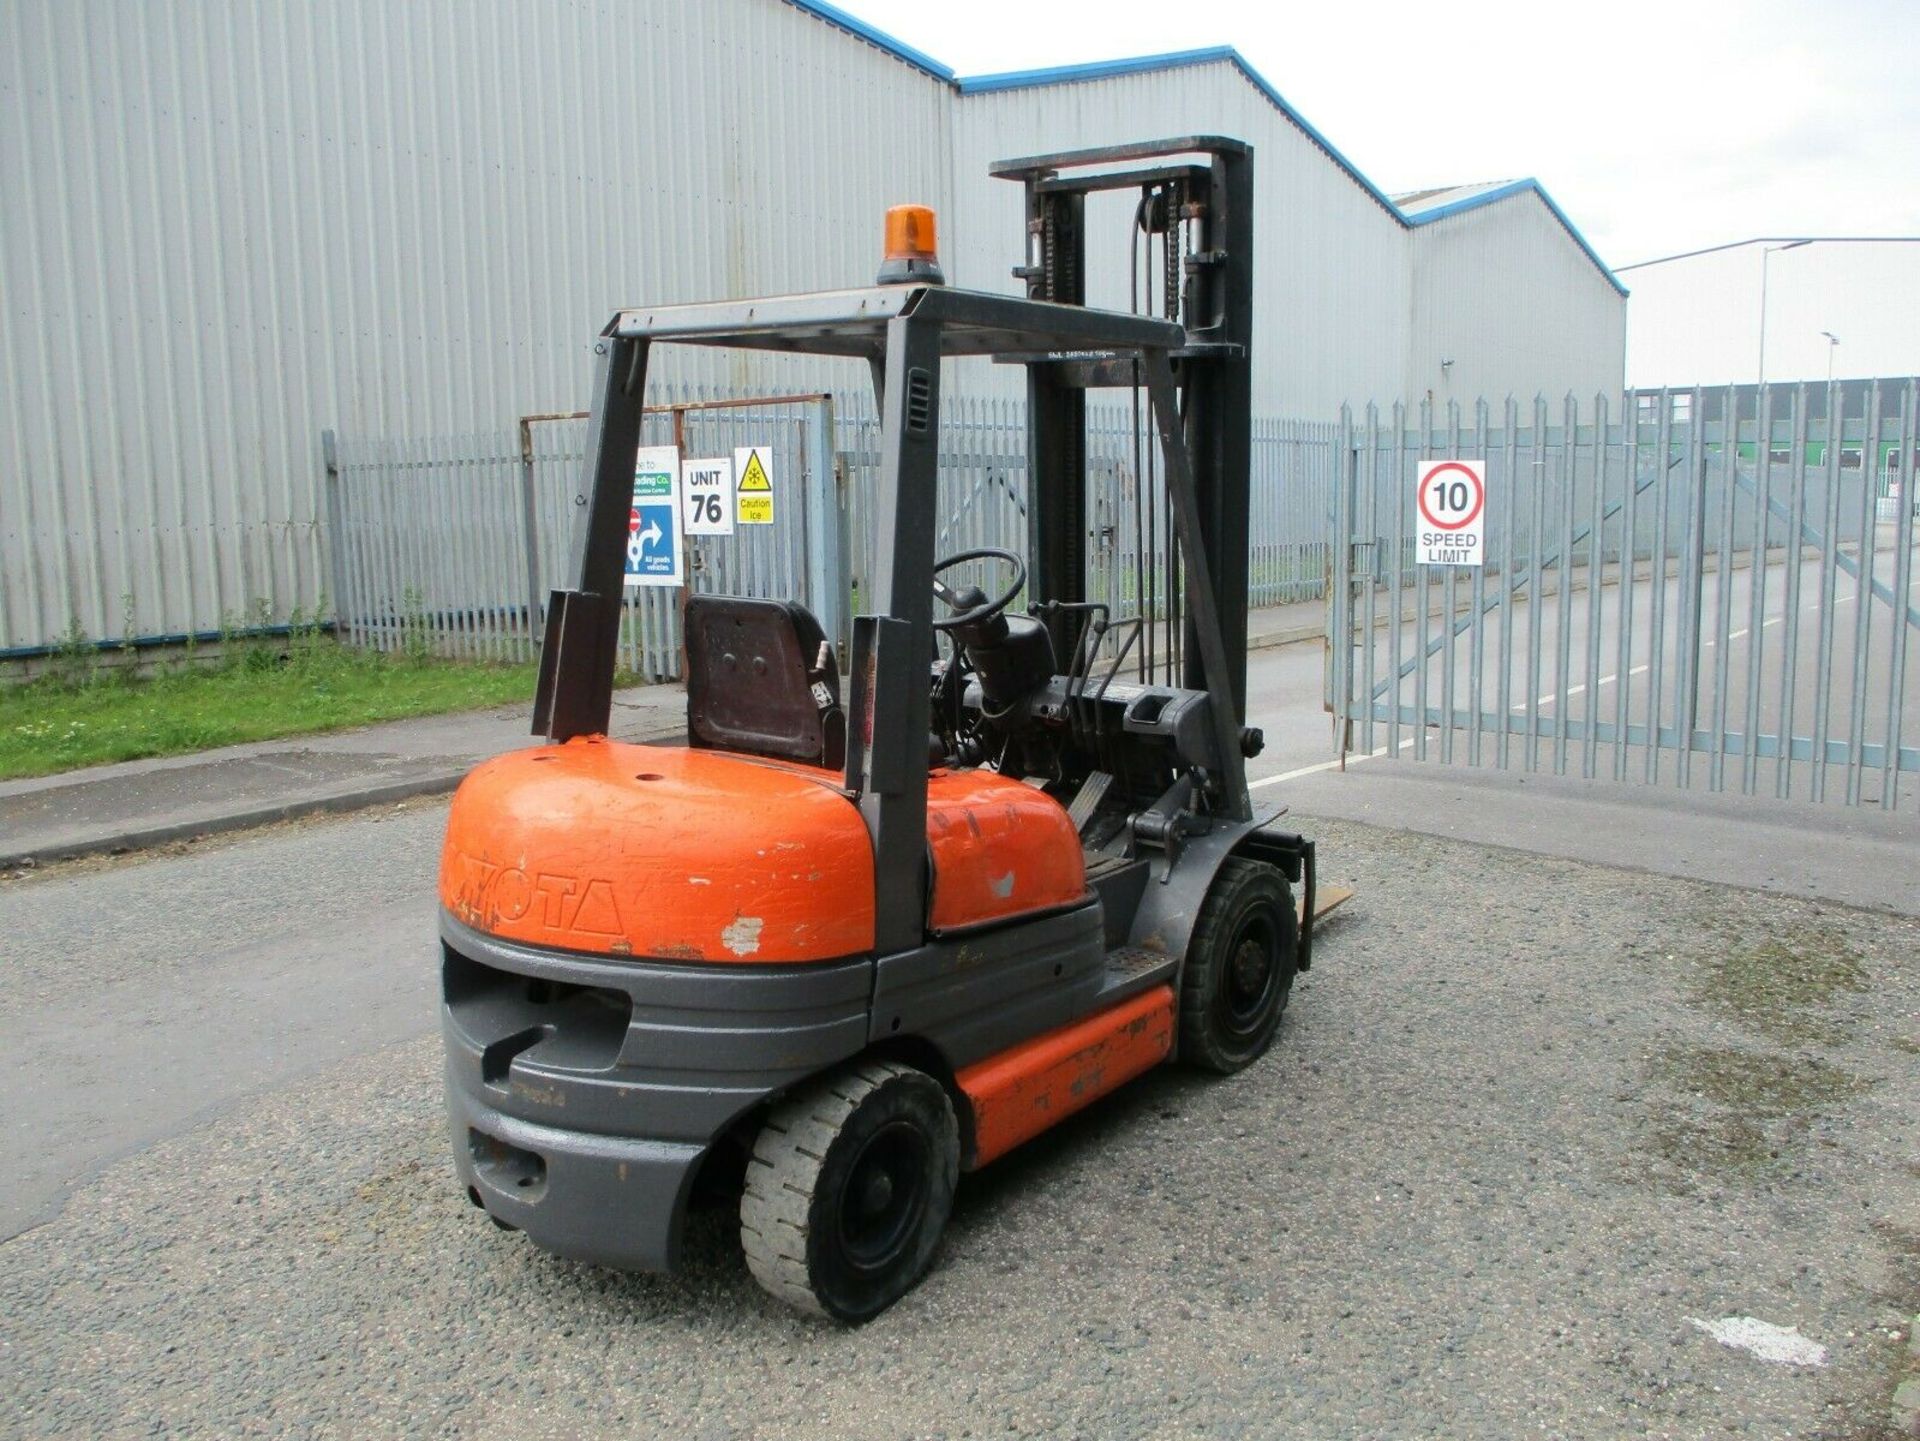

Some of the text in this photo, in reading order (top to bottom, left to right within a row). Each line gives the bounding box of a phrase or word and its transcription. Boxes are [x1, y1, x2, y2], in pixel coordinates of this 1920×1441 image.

[646, 460, 655, 469] to
[635, 476, 656, 486] ading
[690, 471, 722, 486] UNIT
[740, 499, 771, 508] Caution
[1433, 482, 1468, 511] 10
[691, 494, 723, 524] 76
[1423, 533, 1477, 547] SPEED
[1428, 549, 1471, 563] LIMIT
